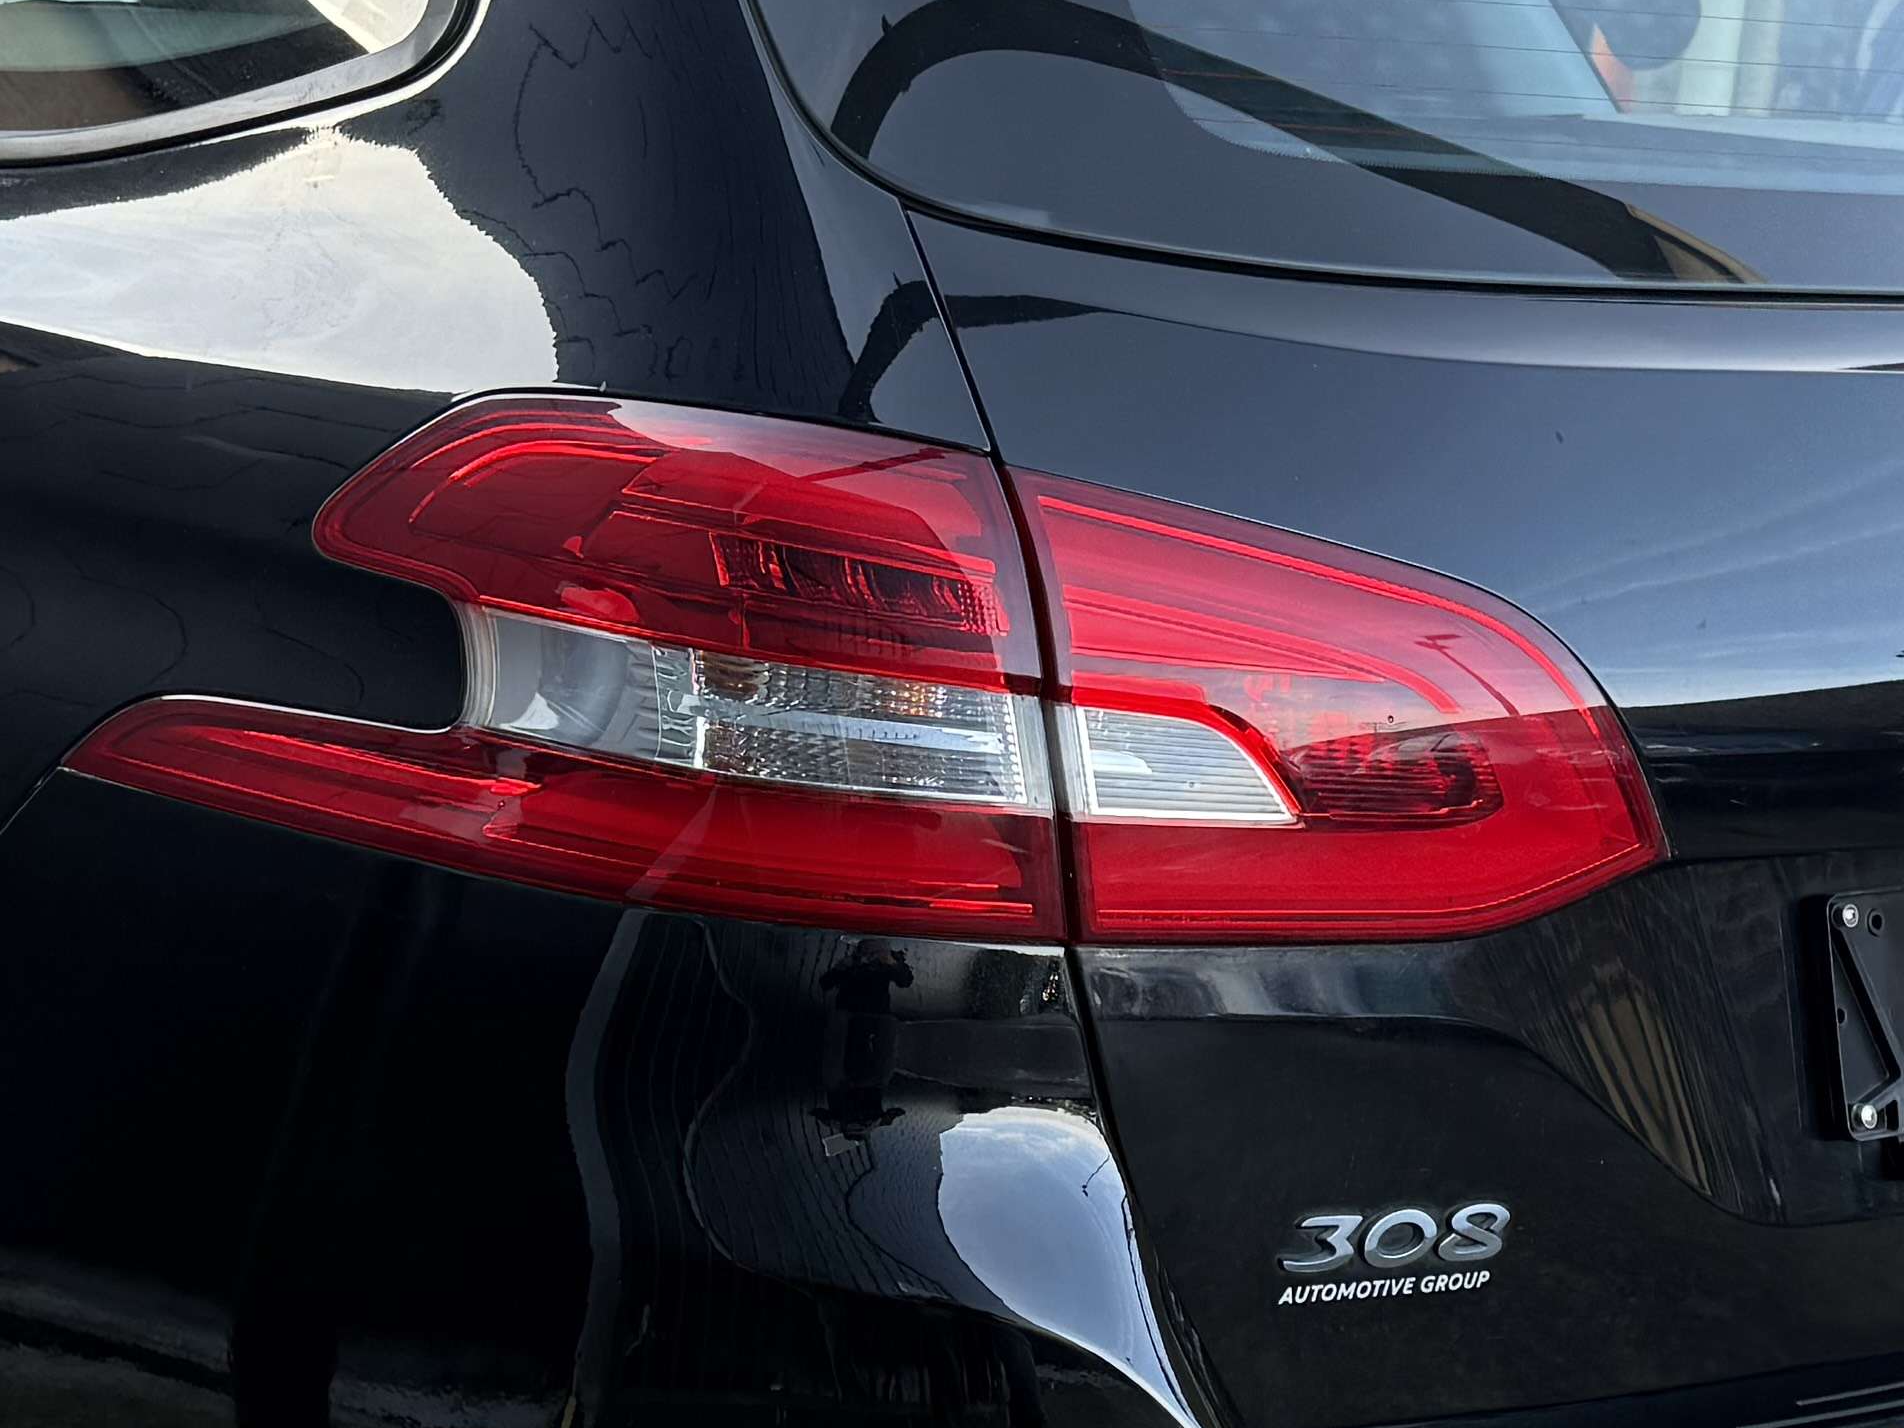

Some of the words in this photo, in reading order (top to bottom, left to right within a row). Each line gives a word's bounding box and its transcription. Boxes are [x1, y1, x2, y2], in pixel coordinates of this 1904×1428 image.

[1279, 1202, 1511, 1273] 308
[1278, 1275, 1414, 1306] AUTOMOTIVE
[1420, 1270, 1491, 1295] GROUP
